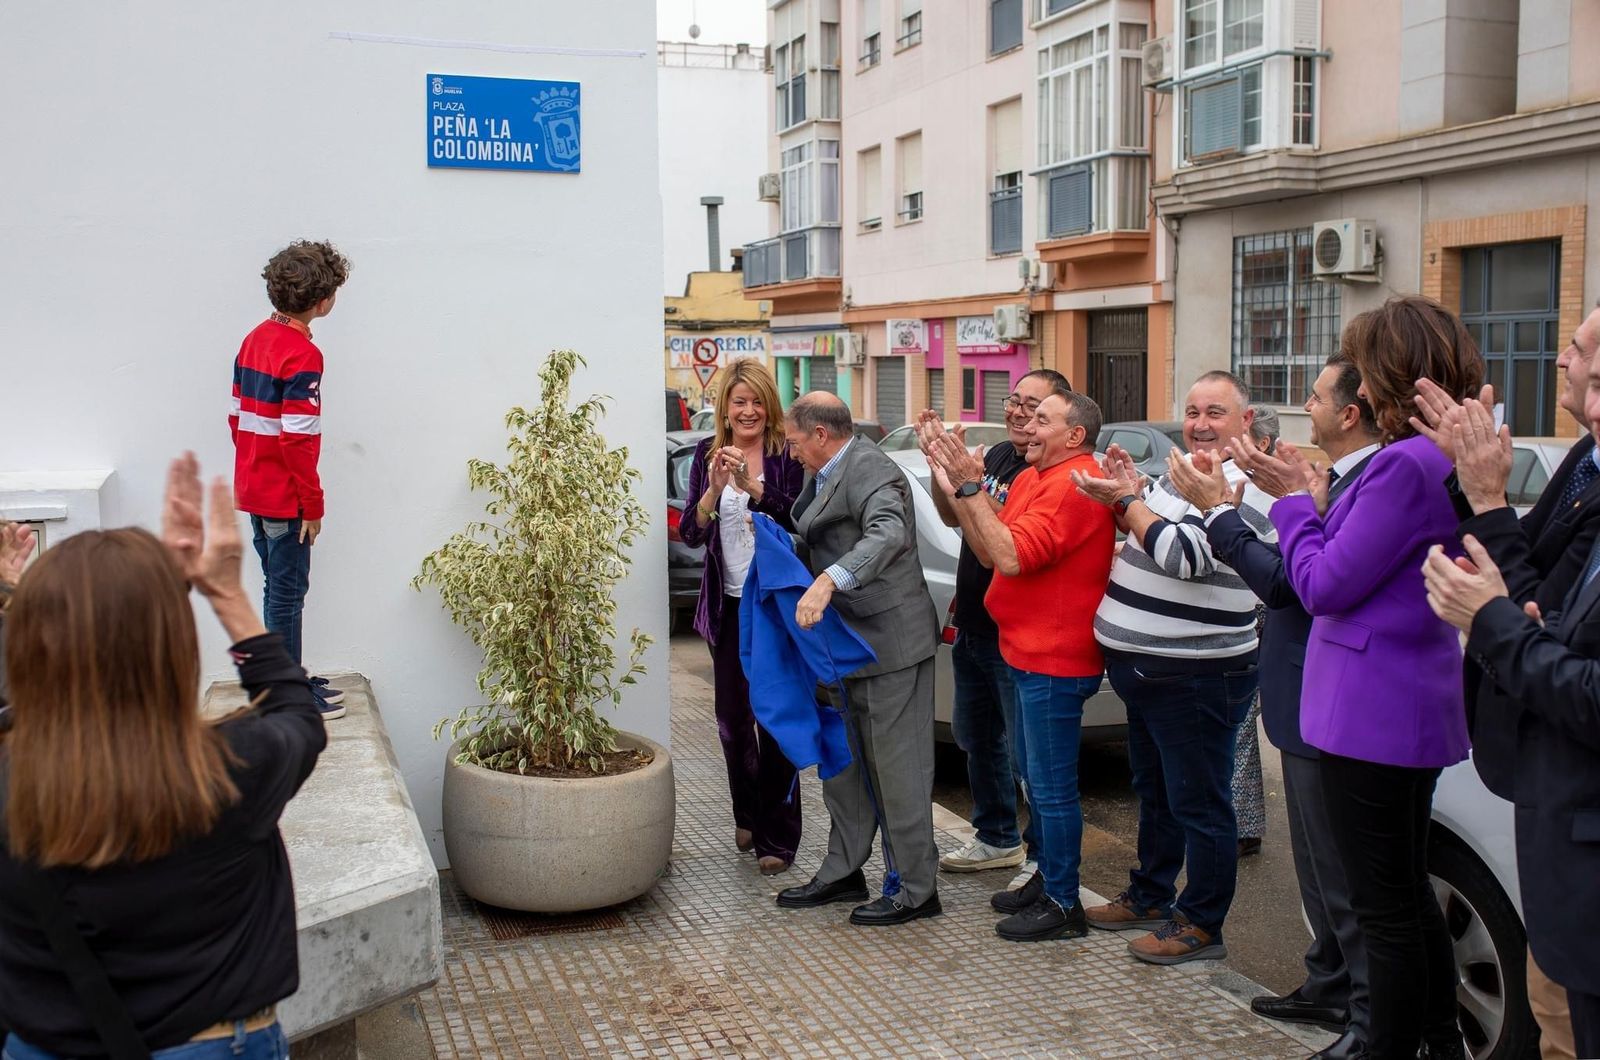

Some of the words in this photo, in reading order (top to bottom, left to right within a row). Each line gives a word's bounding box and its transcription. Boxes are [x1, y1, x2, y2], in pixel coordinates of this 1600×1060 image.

[433, 101, 465, 111] PLAZA
[433, 114, 479, 137] PEÑA
[670, 335, 765, 351] CHRERÍA
